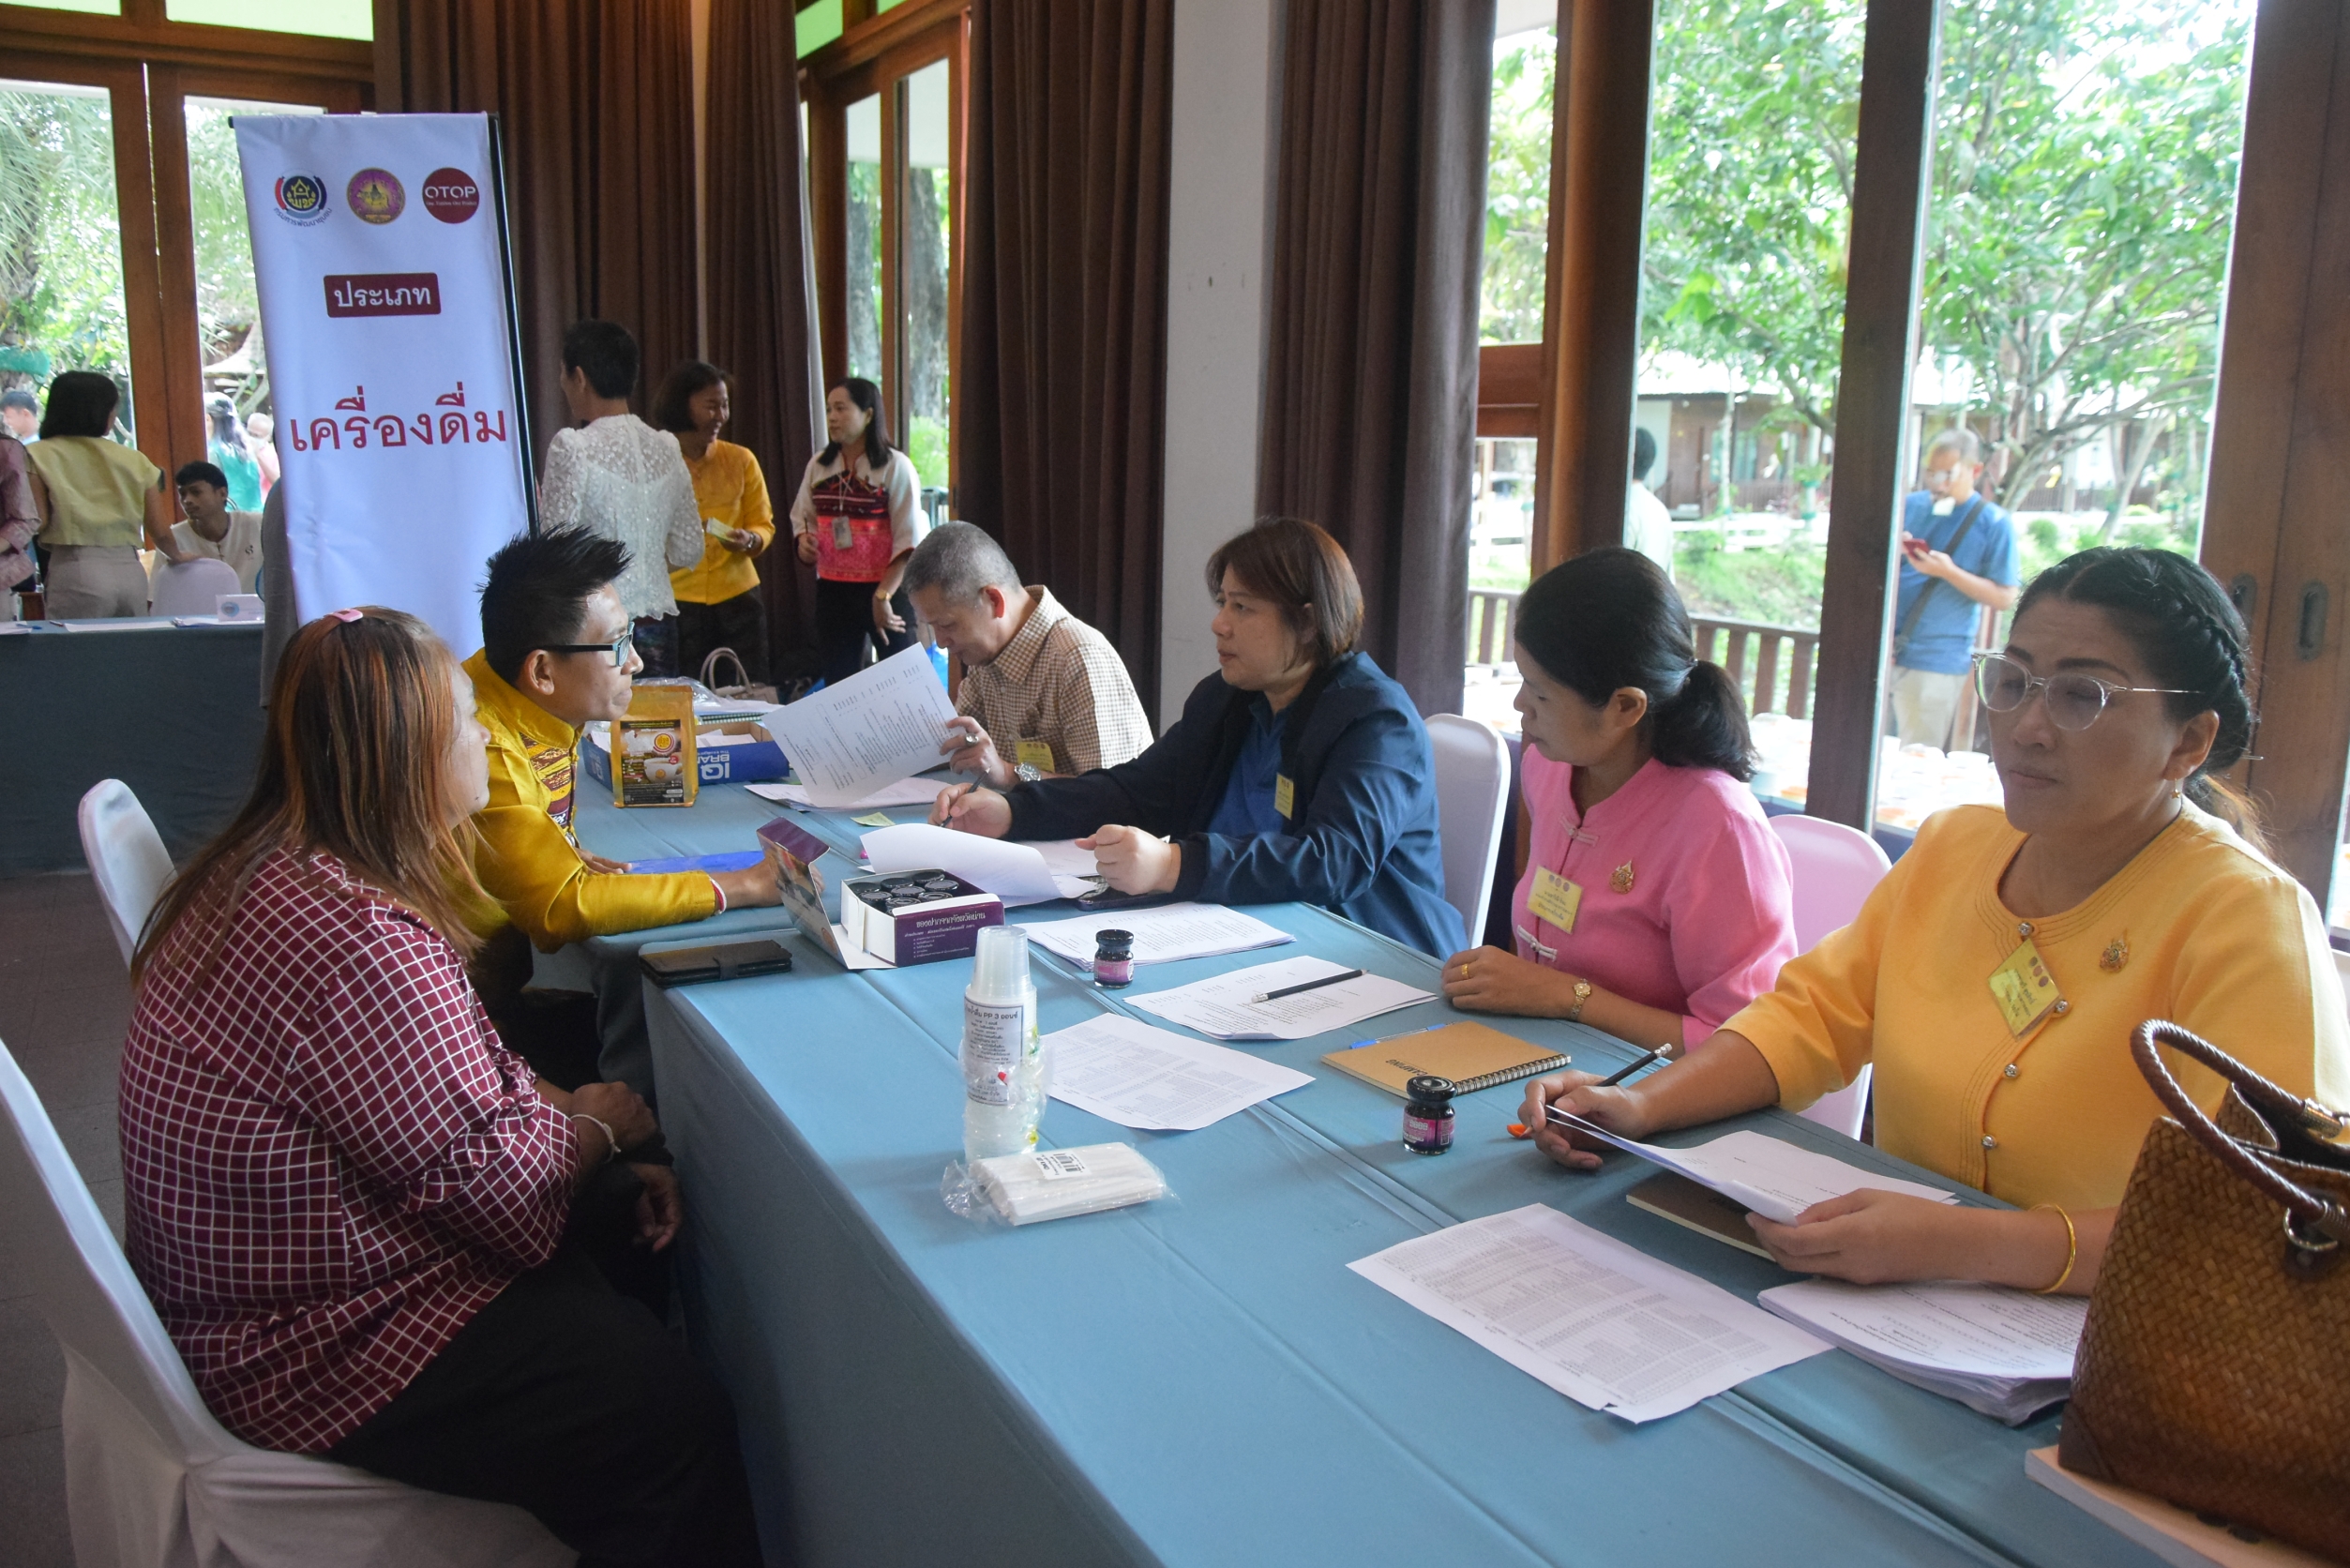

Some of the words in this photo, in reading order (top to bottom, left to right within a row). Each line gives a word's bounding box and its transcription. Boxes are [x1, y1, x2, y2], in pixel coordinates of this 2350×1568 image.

[425, 186, 476, 199] OTOP
[334, 280, 431, 308] ประเภท
[291, 382, 507, 452] เครื่องดื่ม
[700, 762, 730, 780] IQ
